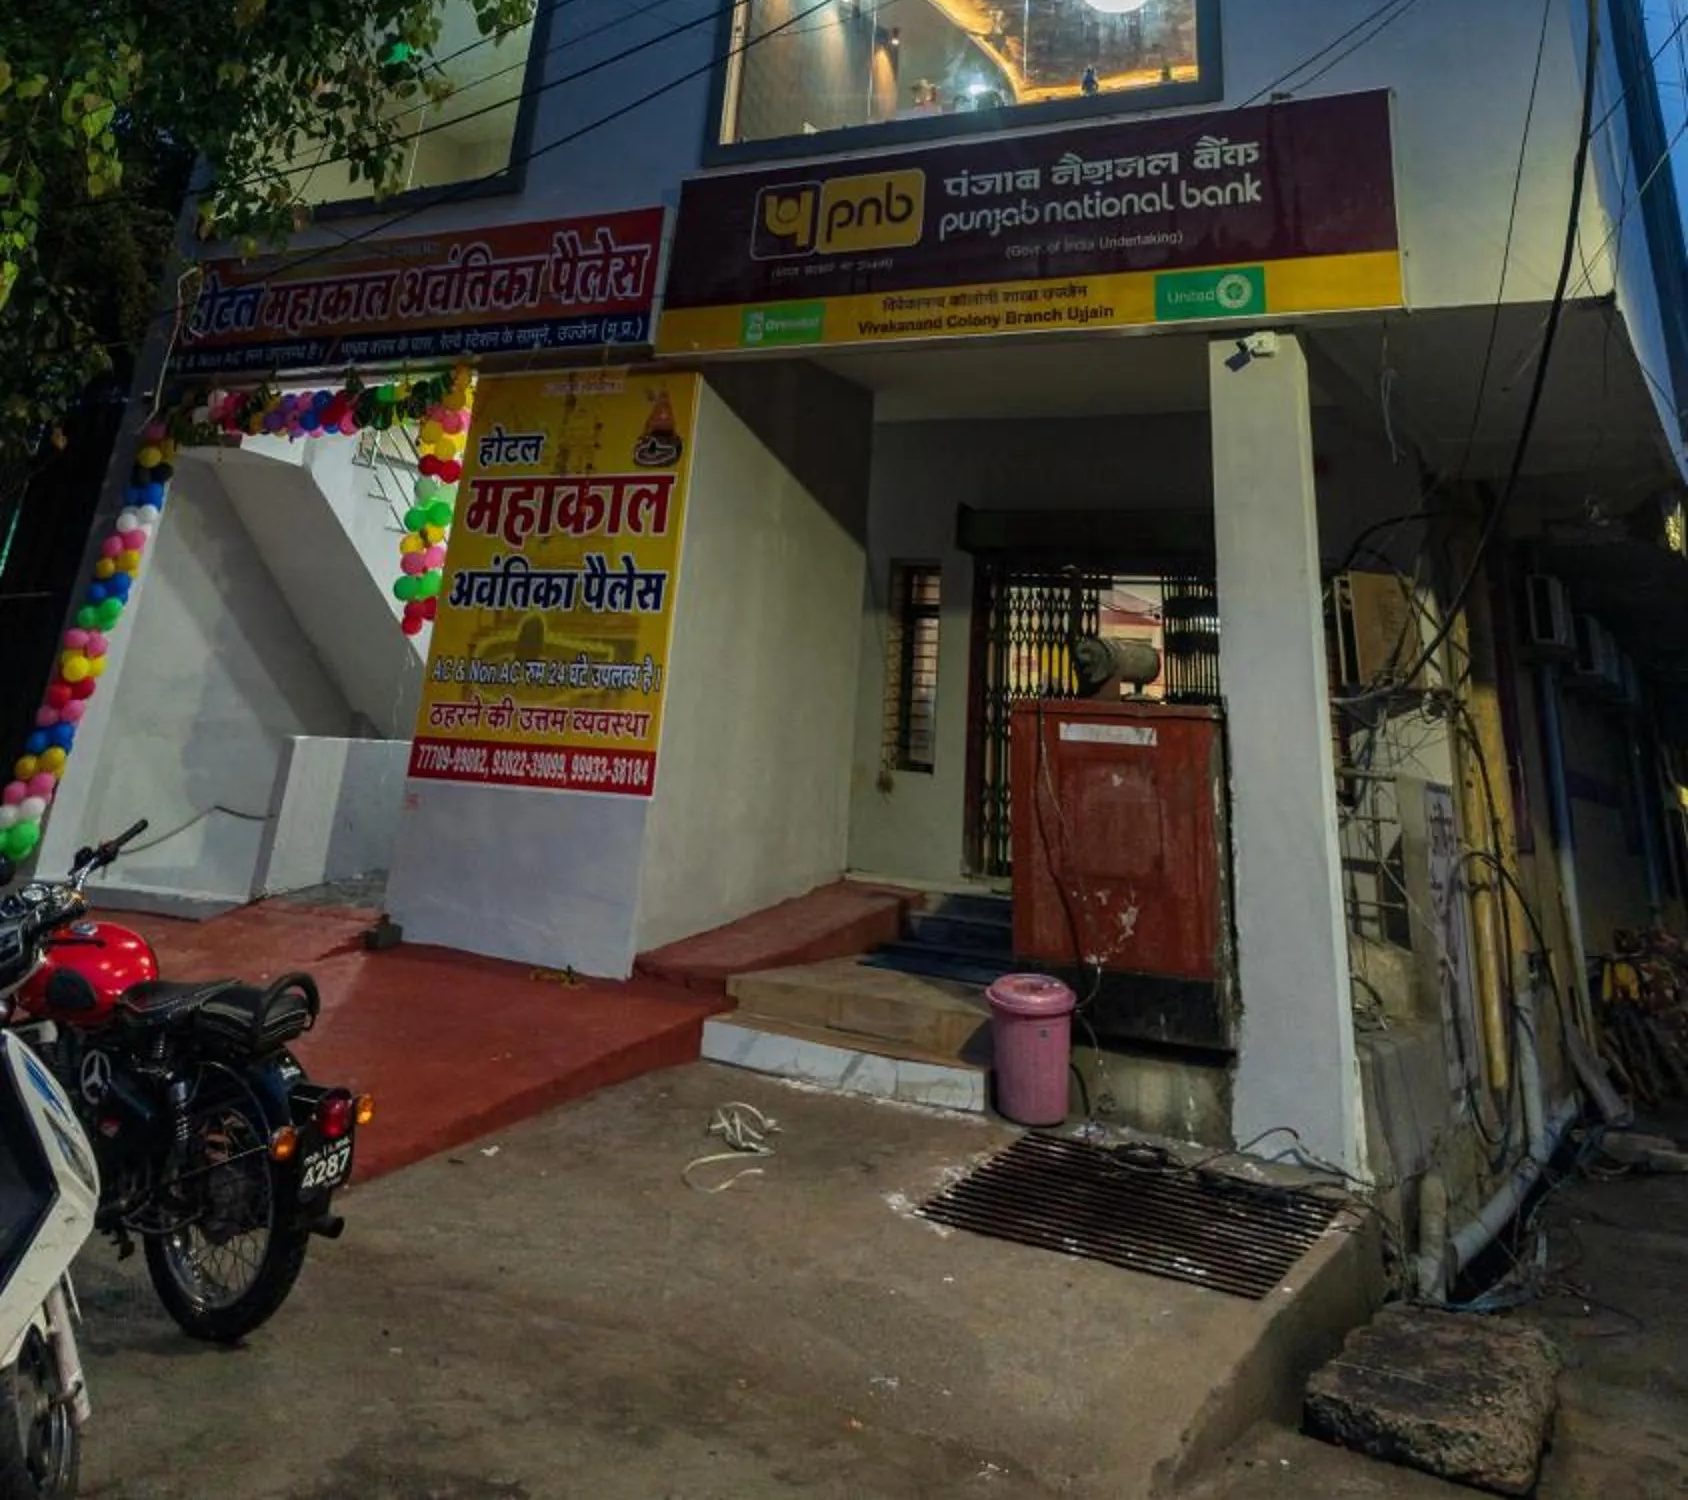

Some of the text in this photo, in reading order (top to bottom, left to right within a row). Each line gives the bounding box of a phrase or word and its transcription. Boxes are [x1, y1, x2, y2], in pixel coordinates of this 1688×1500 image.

[944, 169, 1041, 198] पंजाब
[1193, 135, 1260, 171] बैंक
[826, 180, 915, 243] pnb
[939, 173, 1263, 242] punjab national bank
[263, 269, 400, 337] महाकाल
[397, 242, 550, 318] अवंतिका
[549, 227, 651, 305] पैलेस
[947, 310, 1001, 330] Colony
[1005, 307, 1063, 325] Branch
[1067, 304, 1114, 325] Ujjain
[479, 422, 544, 467] होटल
[465, 474, 675, 549] महाकाल
[449, 555, 668, 612] अवंतिका पैलेस
[469, 660, 497, 684] Non
[430, 692, 484, 730] ठहरने
[486, 693, 516, 730] की
[572, 708, 652, 740] व्यवस्था
[301, 1145, 351, 1188] 4287
